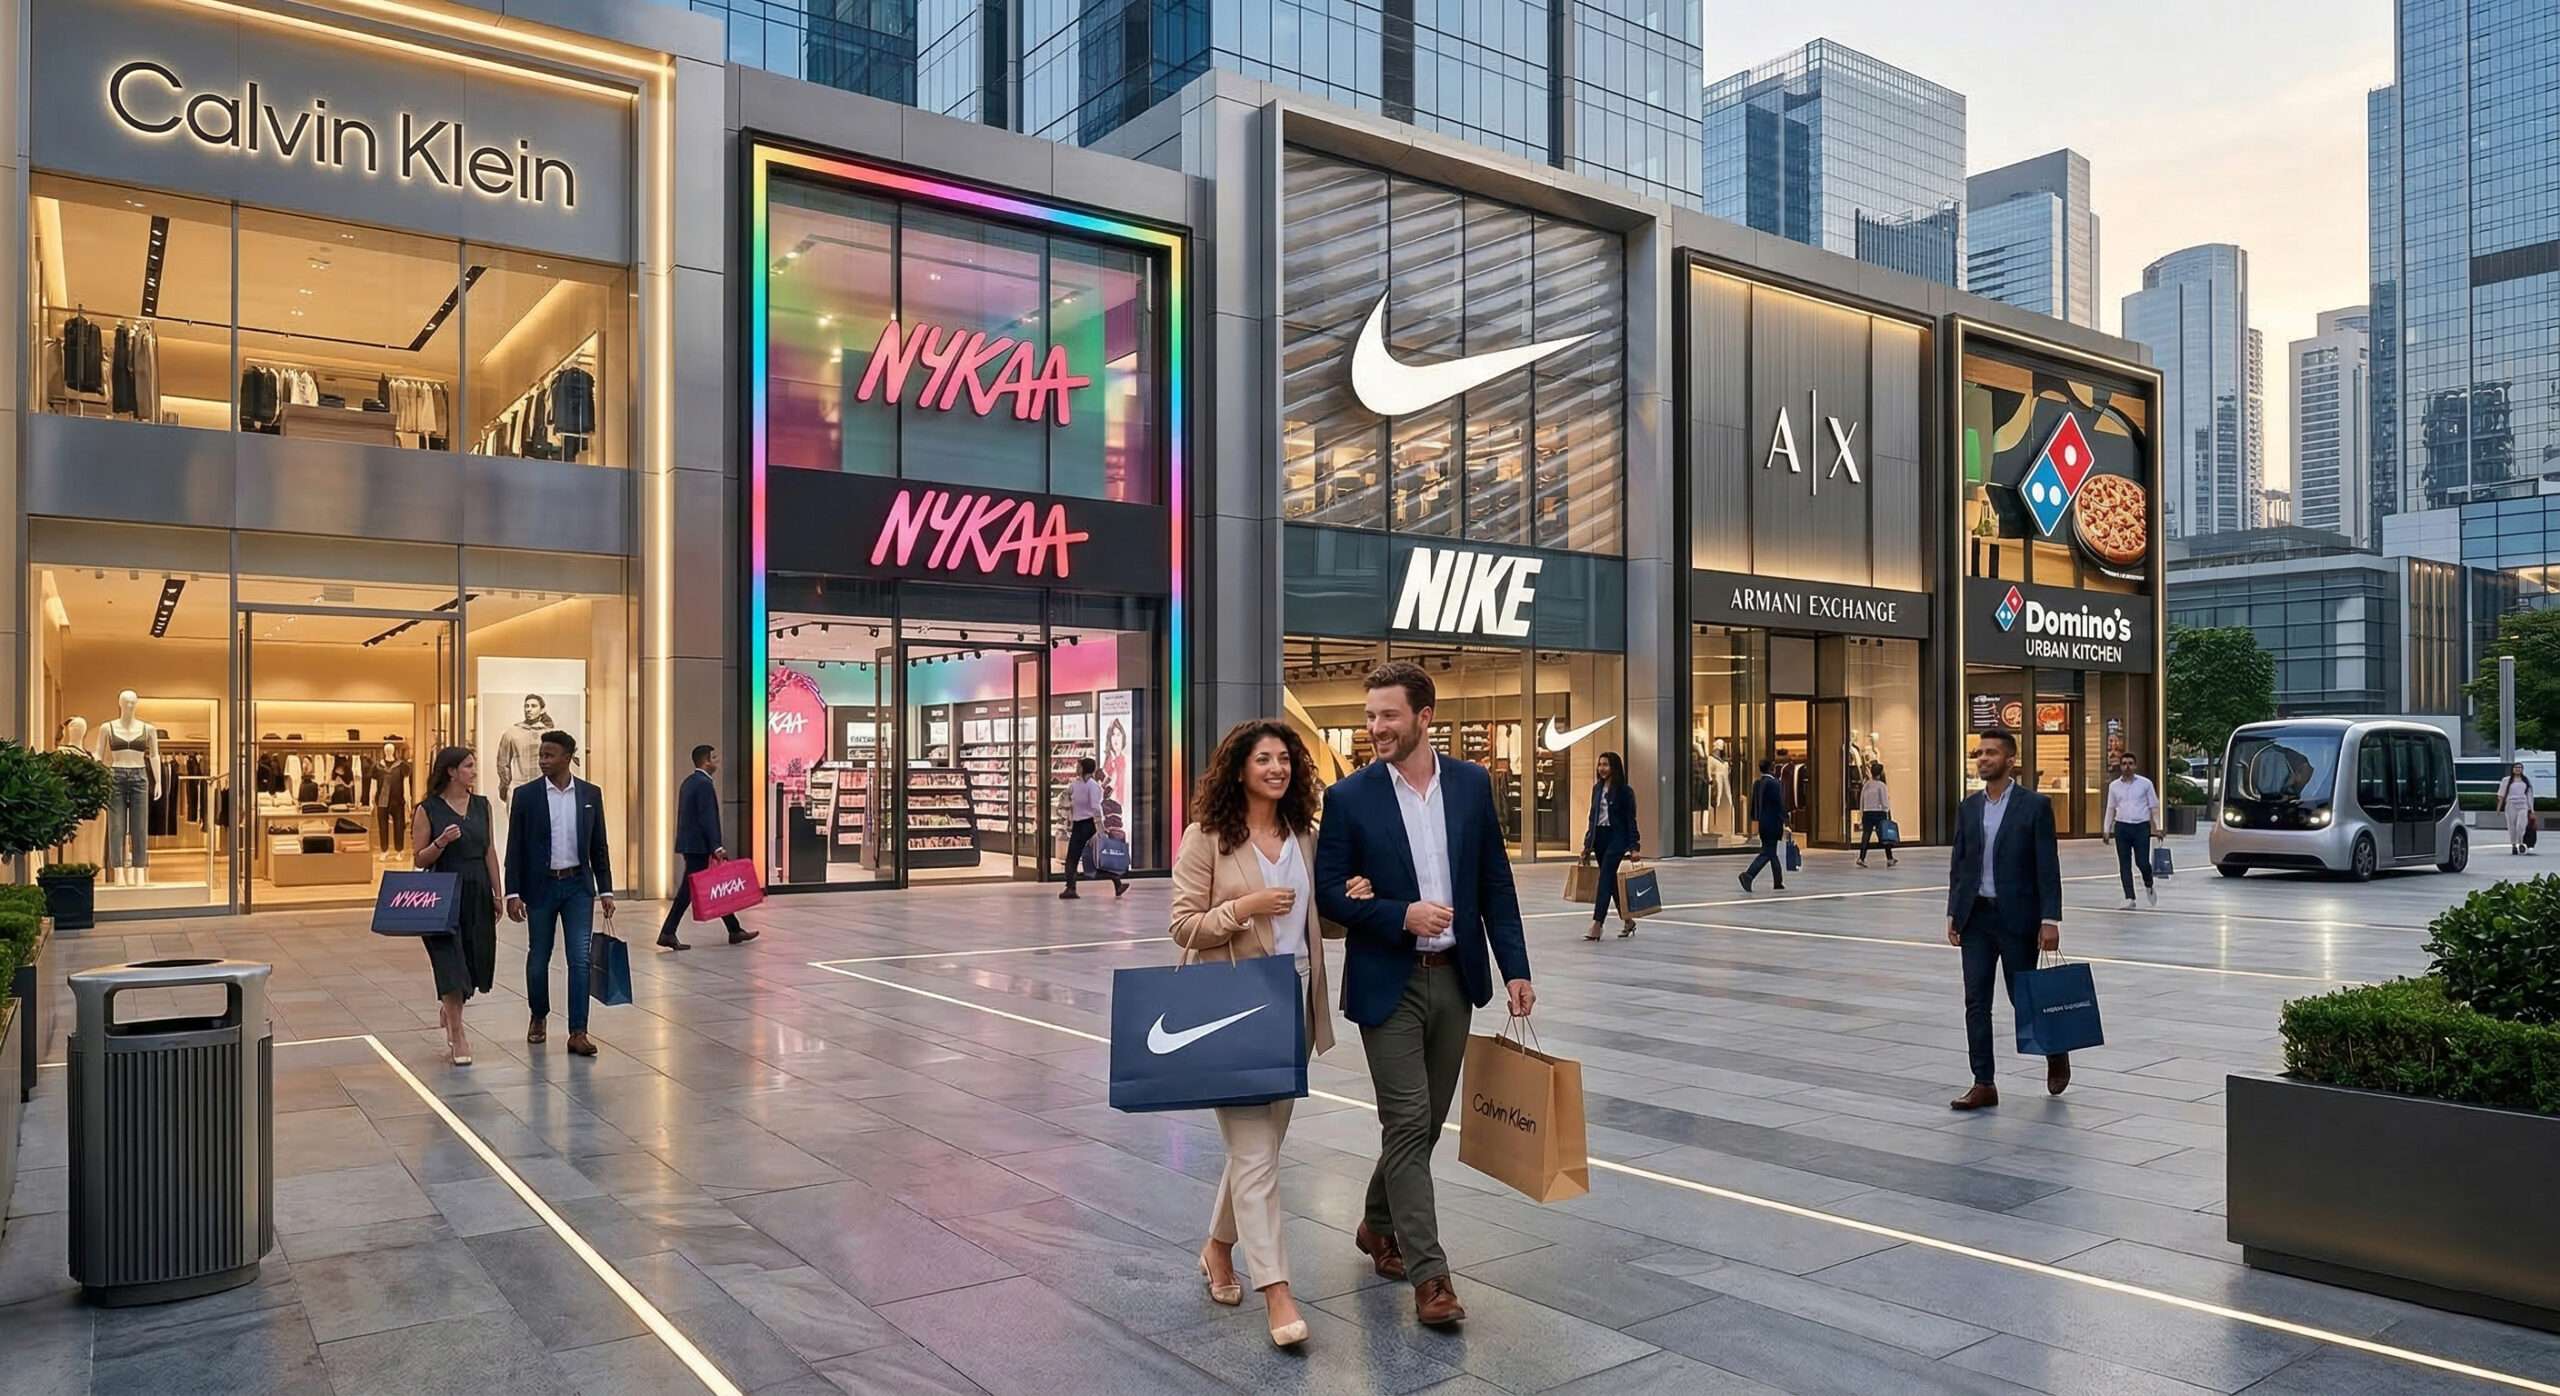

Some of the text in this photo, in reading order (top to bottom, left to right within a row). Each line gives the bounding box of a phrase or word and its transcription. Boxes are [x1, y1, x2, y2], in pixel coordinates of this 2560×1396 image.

[109, 61, 575, 207] Calvin Klein
[856, 319, 1091, 426] NYKAA
[870, 489, 1089, 578] NYKAA
[1392, 546, 1543, 637] NIKE
[1730, 588, 1897, 623] ARMANI EXCHANGE
[2025, 600, 2132, 642] Domino's
[2025, 638, 2122, 663] URBAN KITCHEN
[768, 711, 809, 735] KAA
[389, 890, 442, 908] NYKAA
[710, 877, 747, 901] NYKAA
[1472, 1092, 1537, 1136] Calvin Klein
